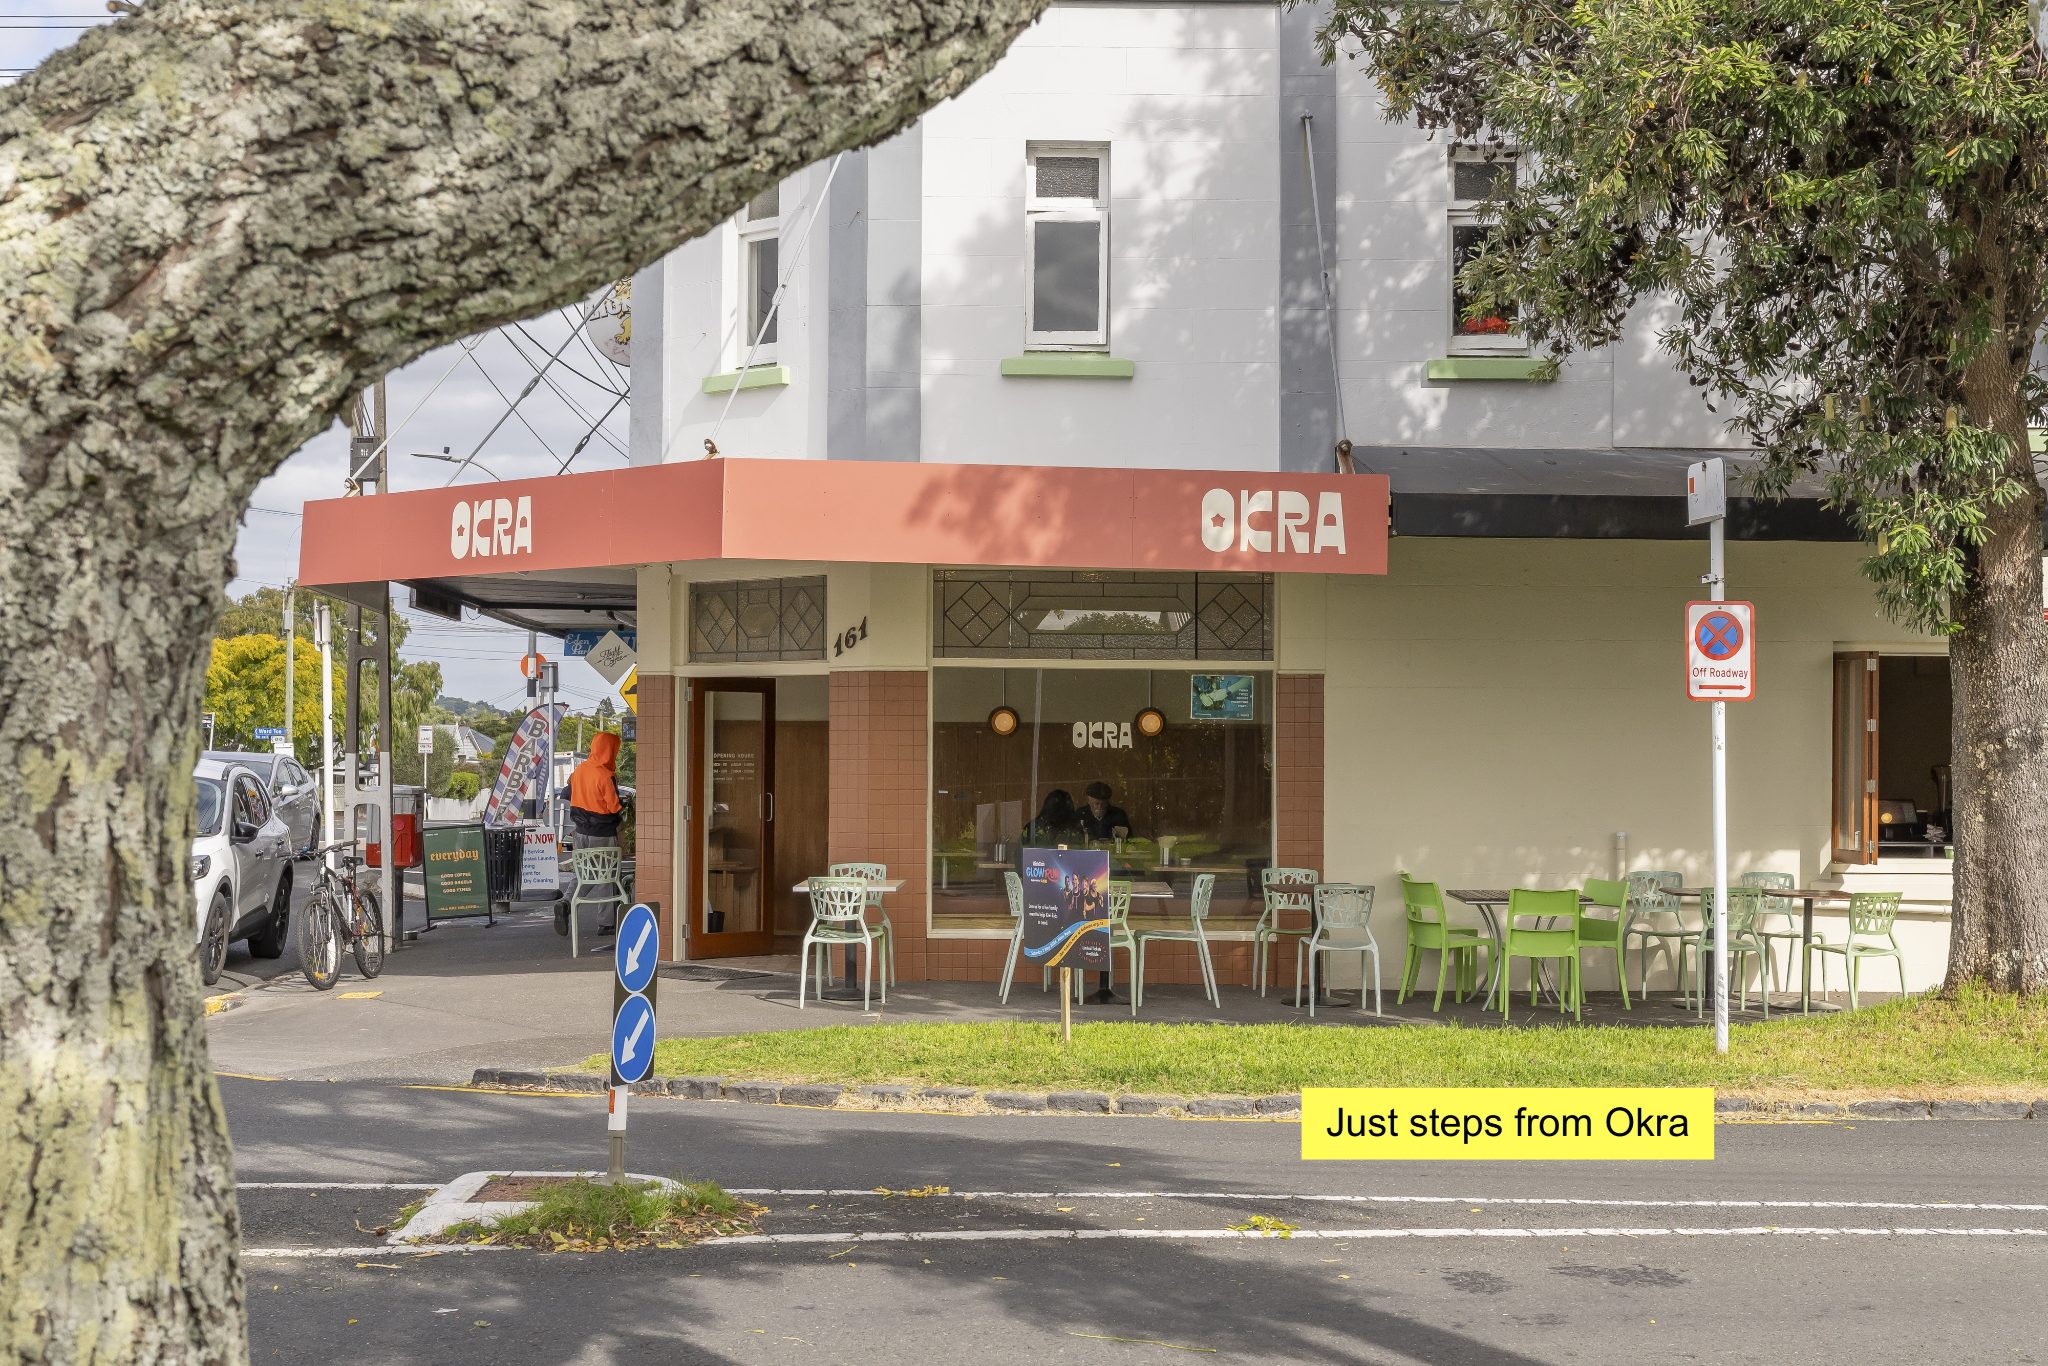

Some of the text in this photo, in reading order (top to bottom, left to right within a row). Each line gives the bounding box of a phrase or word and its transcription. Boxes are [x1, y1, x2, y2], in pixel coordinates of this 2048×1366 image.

[451, 495, 532, 560] OKRA
[1202, 488, 1346, 555] OKRA
[566, 634, 590, 645] Eden
[834, 616, 868, 657] 161
[1692, 667, 1749, 680] Off Roadway
[1072, 721, 1133, 749] OKRA
[535, 833, 555, 845] NOW
[430, 848, 480, 862] everyday
[1026, 867, 1045, 878] GLOW
